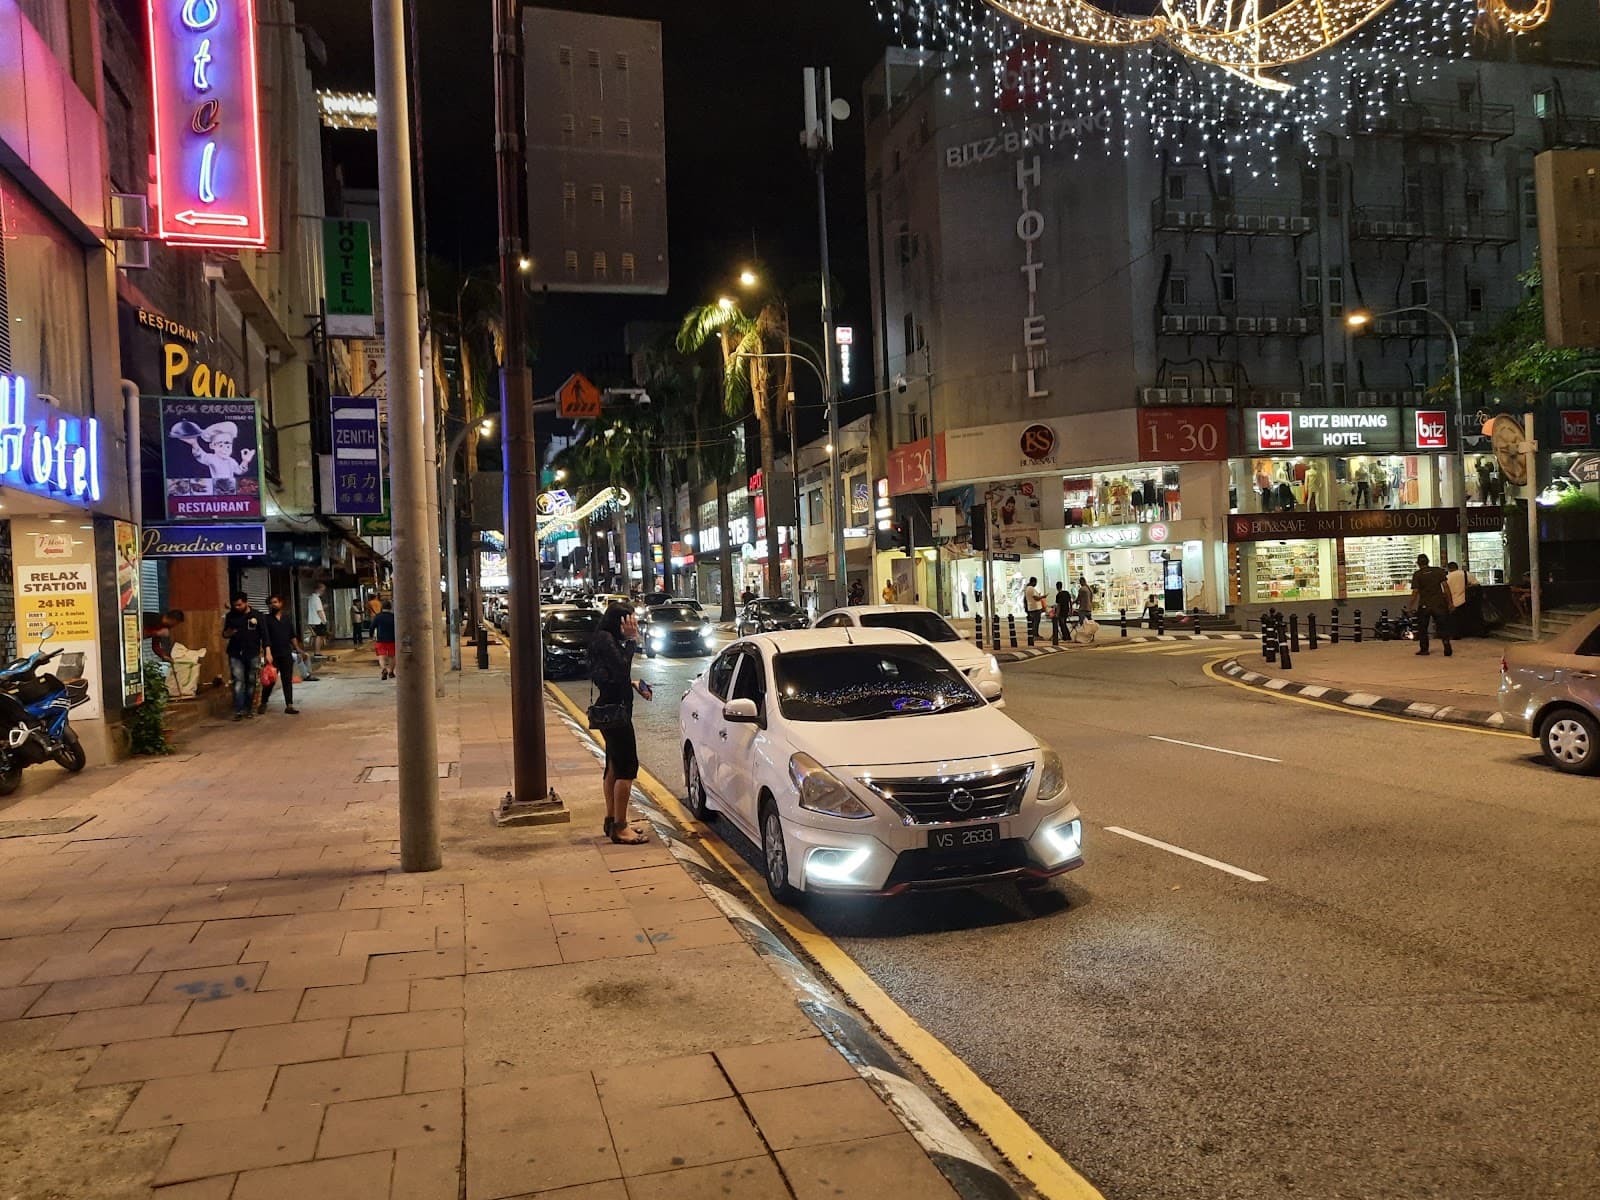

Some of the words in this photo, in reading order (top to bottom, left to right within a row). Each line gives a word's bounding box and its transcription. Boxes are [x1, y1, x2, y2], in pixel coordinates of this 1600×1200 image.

[1015, 155, 1050, 398] HOTEL
[138, 309, 199, 343] RESTORAN
[1261, 418, 1289, 440] bitz
[1299, 415, 1329, 428] BITZ
[1331, 414, 1388, 428] BINTANG
[1418, 417, 1444, 438] bitz
[336, 429, 376, 444] ZENITH
[1179, 423, 1218, 452] 30
[1323, 432, 1366, 446] HOTEL
[178, 501, 250, 513] RESTAURANT
[1406, 510, 1440, 530] Only
[142, 528, 225, 555] Paradise
[226, 543, 264, 551] HOTEL
[31, 571, 79, 582] RELAX
[24, 582, 87, 593] STATION
[936, 833, 953, 847] VS
